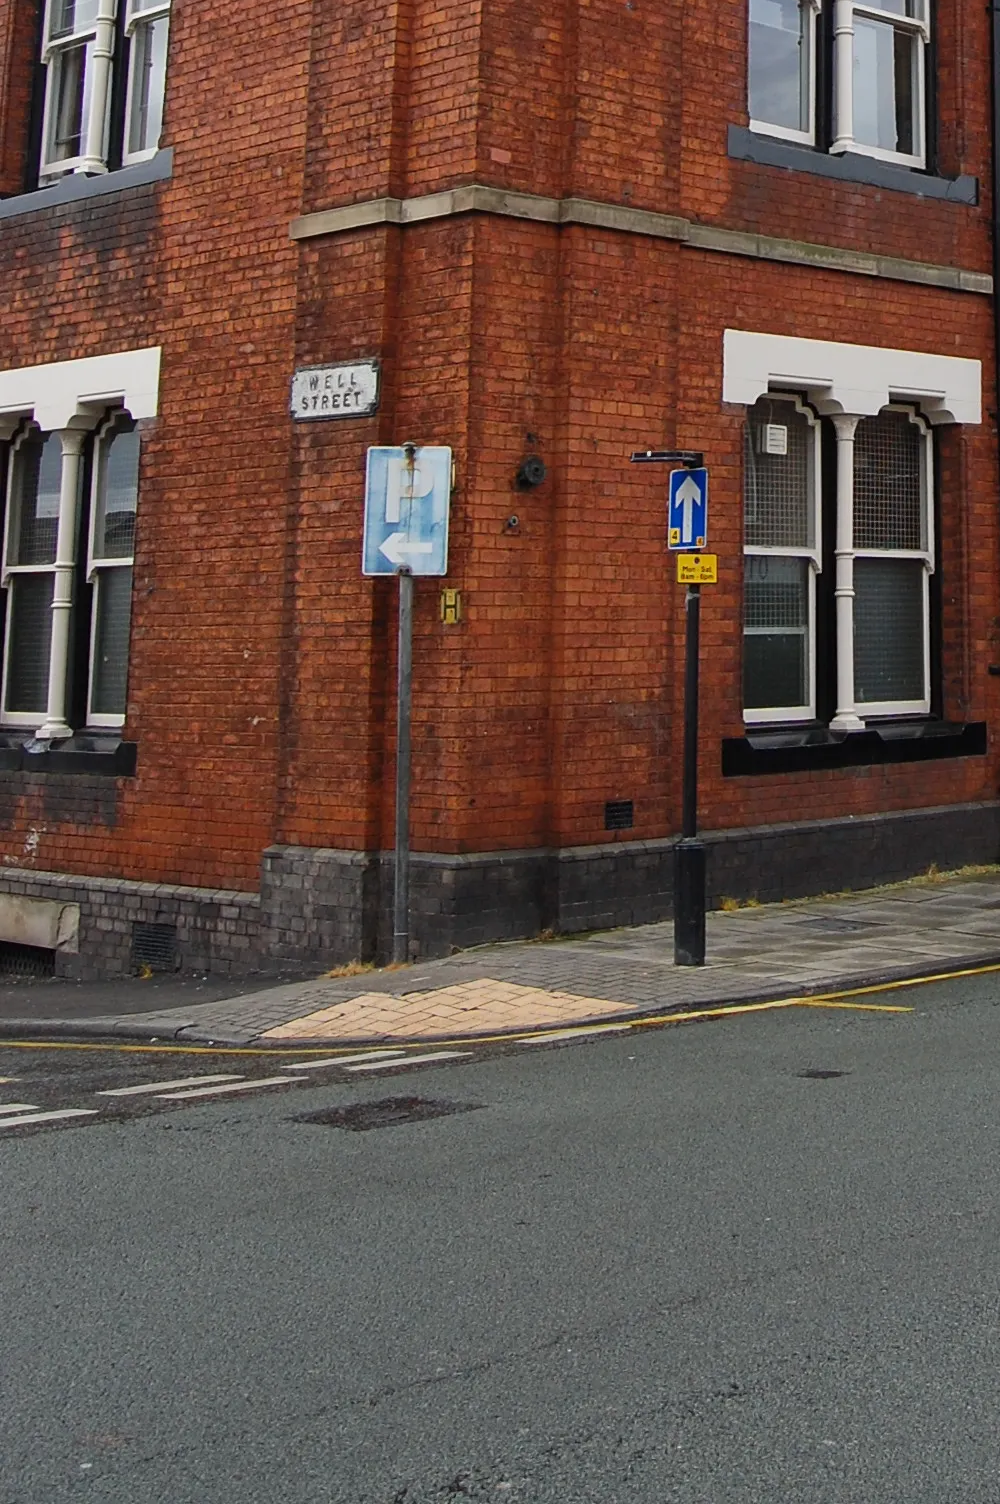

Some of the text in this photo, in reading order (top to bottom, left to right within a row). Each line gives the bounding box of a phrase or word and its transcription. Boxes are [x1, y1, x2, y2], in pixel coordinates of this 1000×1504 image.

[309, 372, 357, 391] WELL
[302, 391, 361, 410] STREET
[385, 459, 434, 523] P
[672, 530, 678, 540] 4
[443, 590, 458, 623] H
